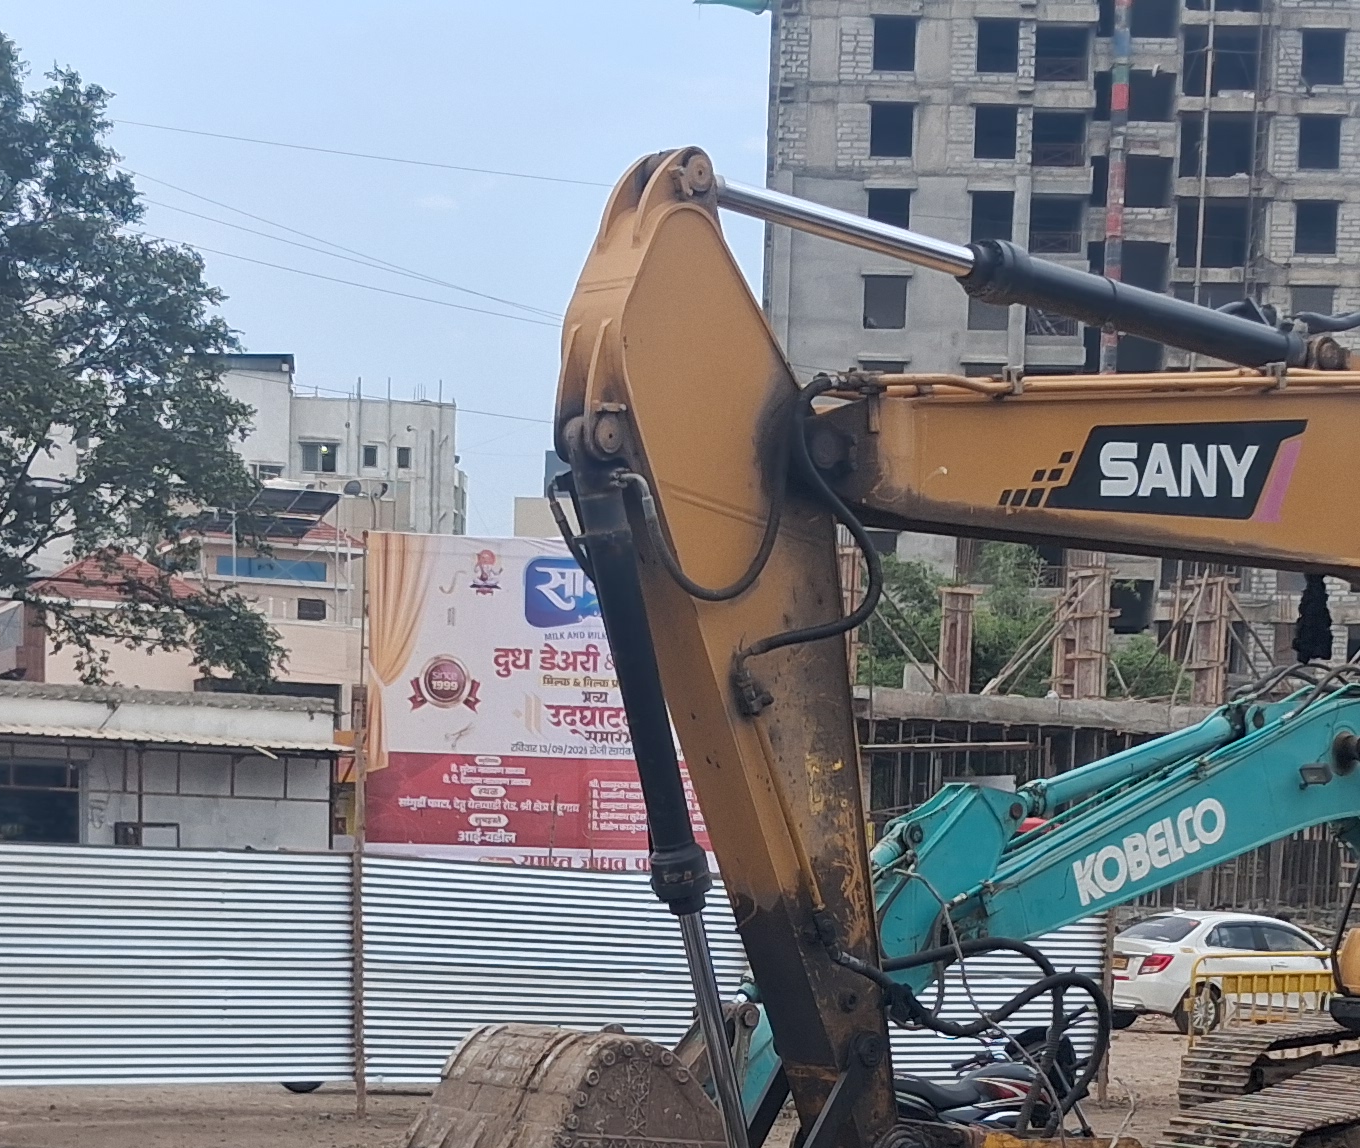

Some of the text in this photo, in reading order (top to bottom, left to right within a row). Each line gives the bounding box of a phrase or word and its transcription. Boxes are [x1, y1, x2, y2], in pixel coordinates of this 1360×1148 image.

[1099, 441, 1260, 498] SANY
[544, 631, 565, 640] MILK
[567, 631, 585, 640] AND
[493, 648, 533, 678] दुध
[539, 643, 600, 673] डेअरी
[431, 680, 458, 690] 1999
[542, 674, 570, 686] मिल्क
[572, 678, 581, 687] &
[582, 691, 608, 703] भव्य
[1072, 798, 1226, 906] KOBELCO
